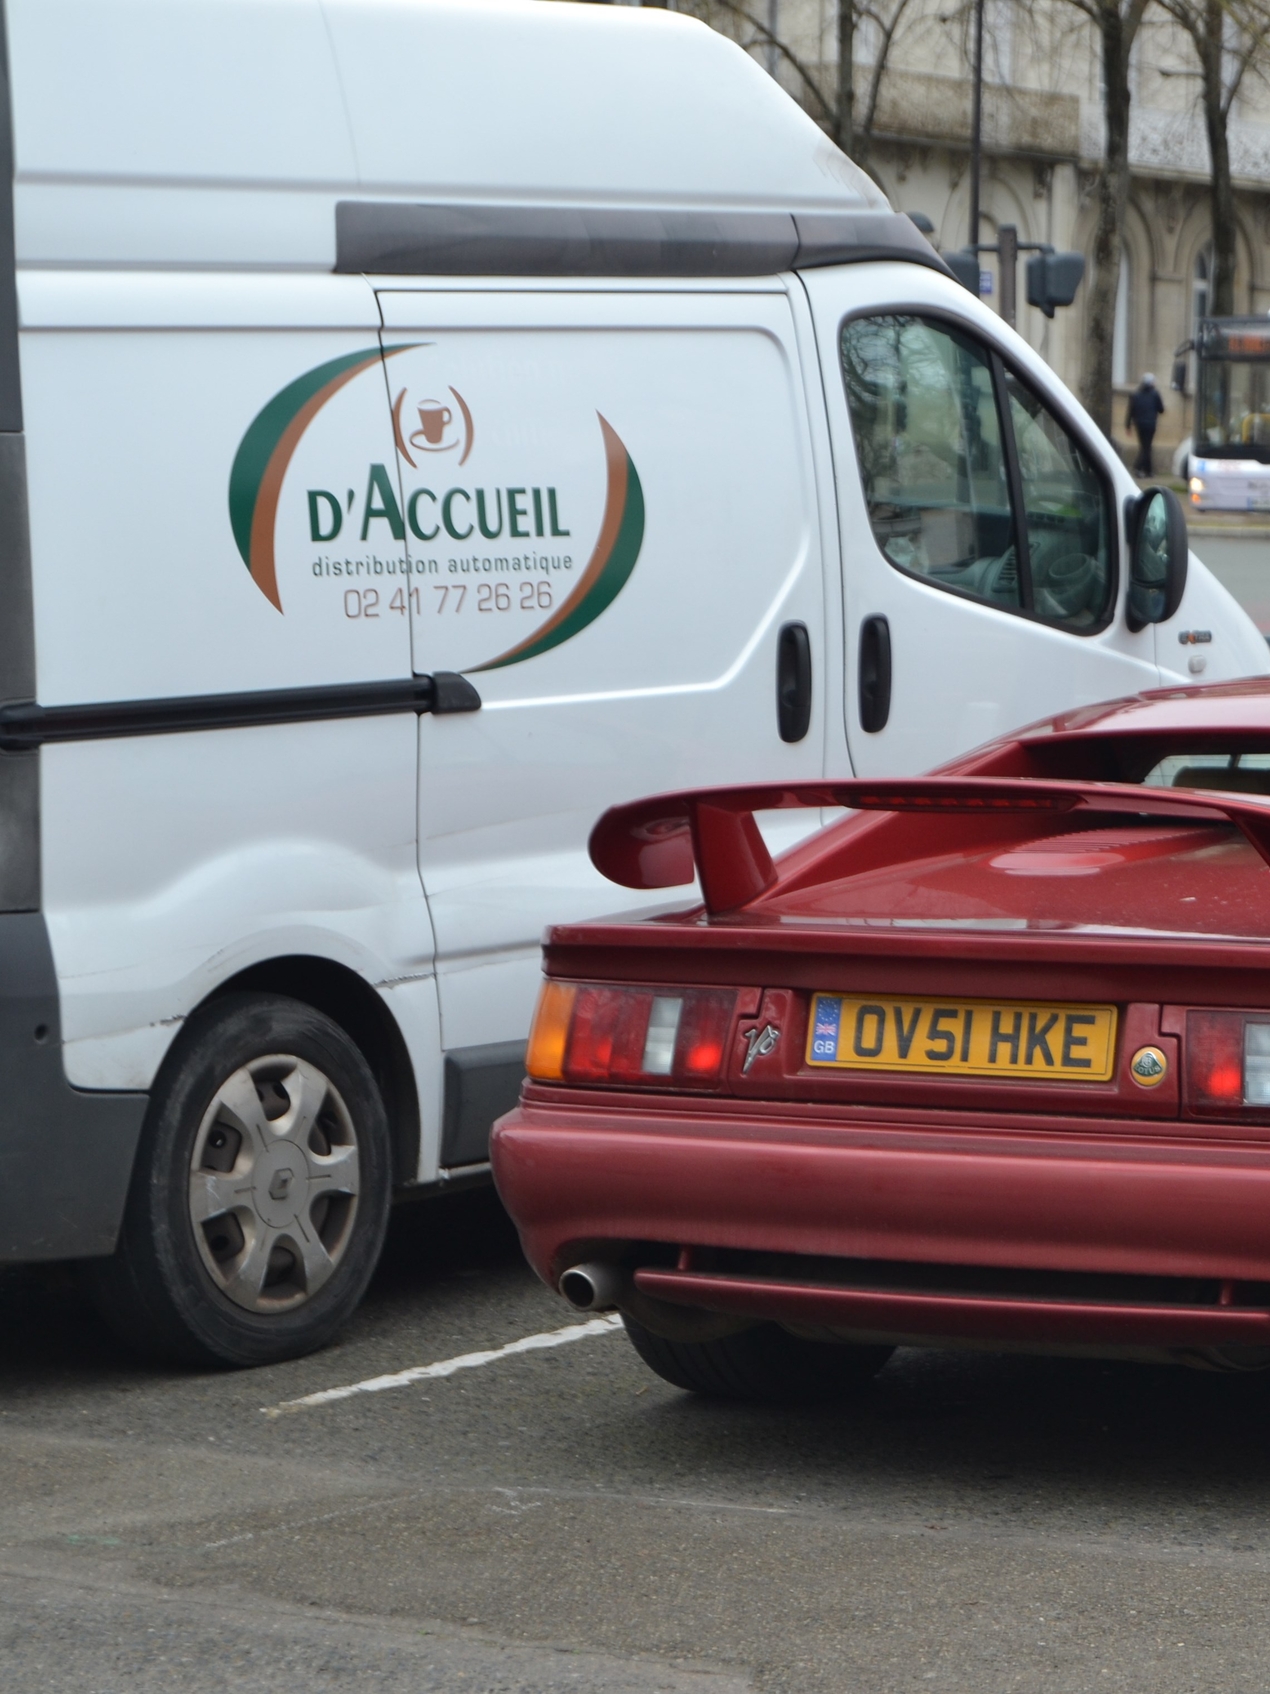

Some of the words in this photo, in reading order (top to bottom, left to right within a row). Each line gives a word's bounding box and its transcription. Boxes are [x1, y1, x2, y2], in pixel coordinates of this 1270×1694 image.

[307, 463, 570, 542] D'ACCUEIL
[312, 554, 439, 577] distribution
[447, 553, 573, 576] automatique
[344, 588, 380, 619] 02
[388, 586, 421, 616] 41
[434, 584, 467, 614] 77
[477, 583, 511, 612] 26
[519, 580, 553, 610] 26
[813, 1039, 835, 1055] GB
[852, 1004, 971, 1063] OV51
[987, 1009, 1096, 1068] HKE
[1134, 1063, 1162, 1075] LOTUS
